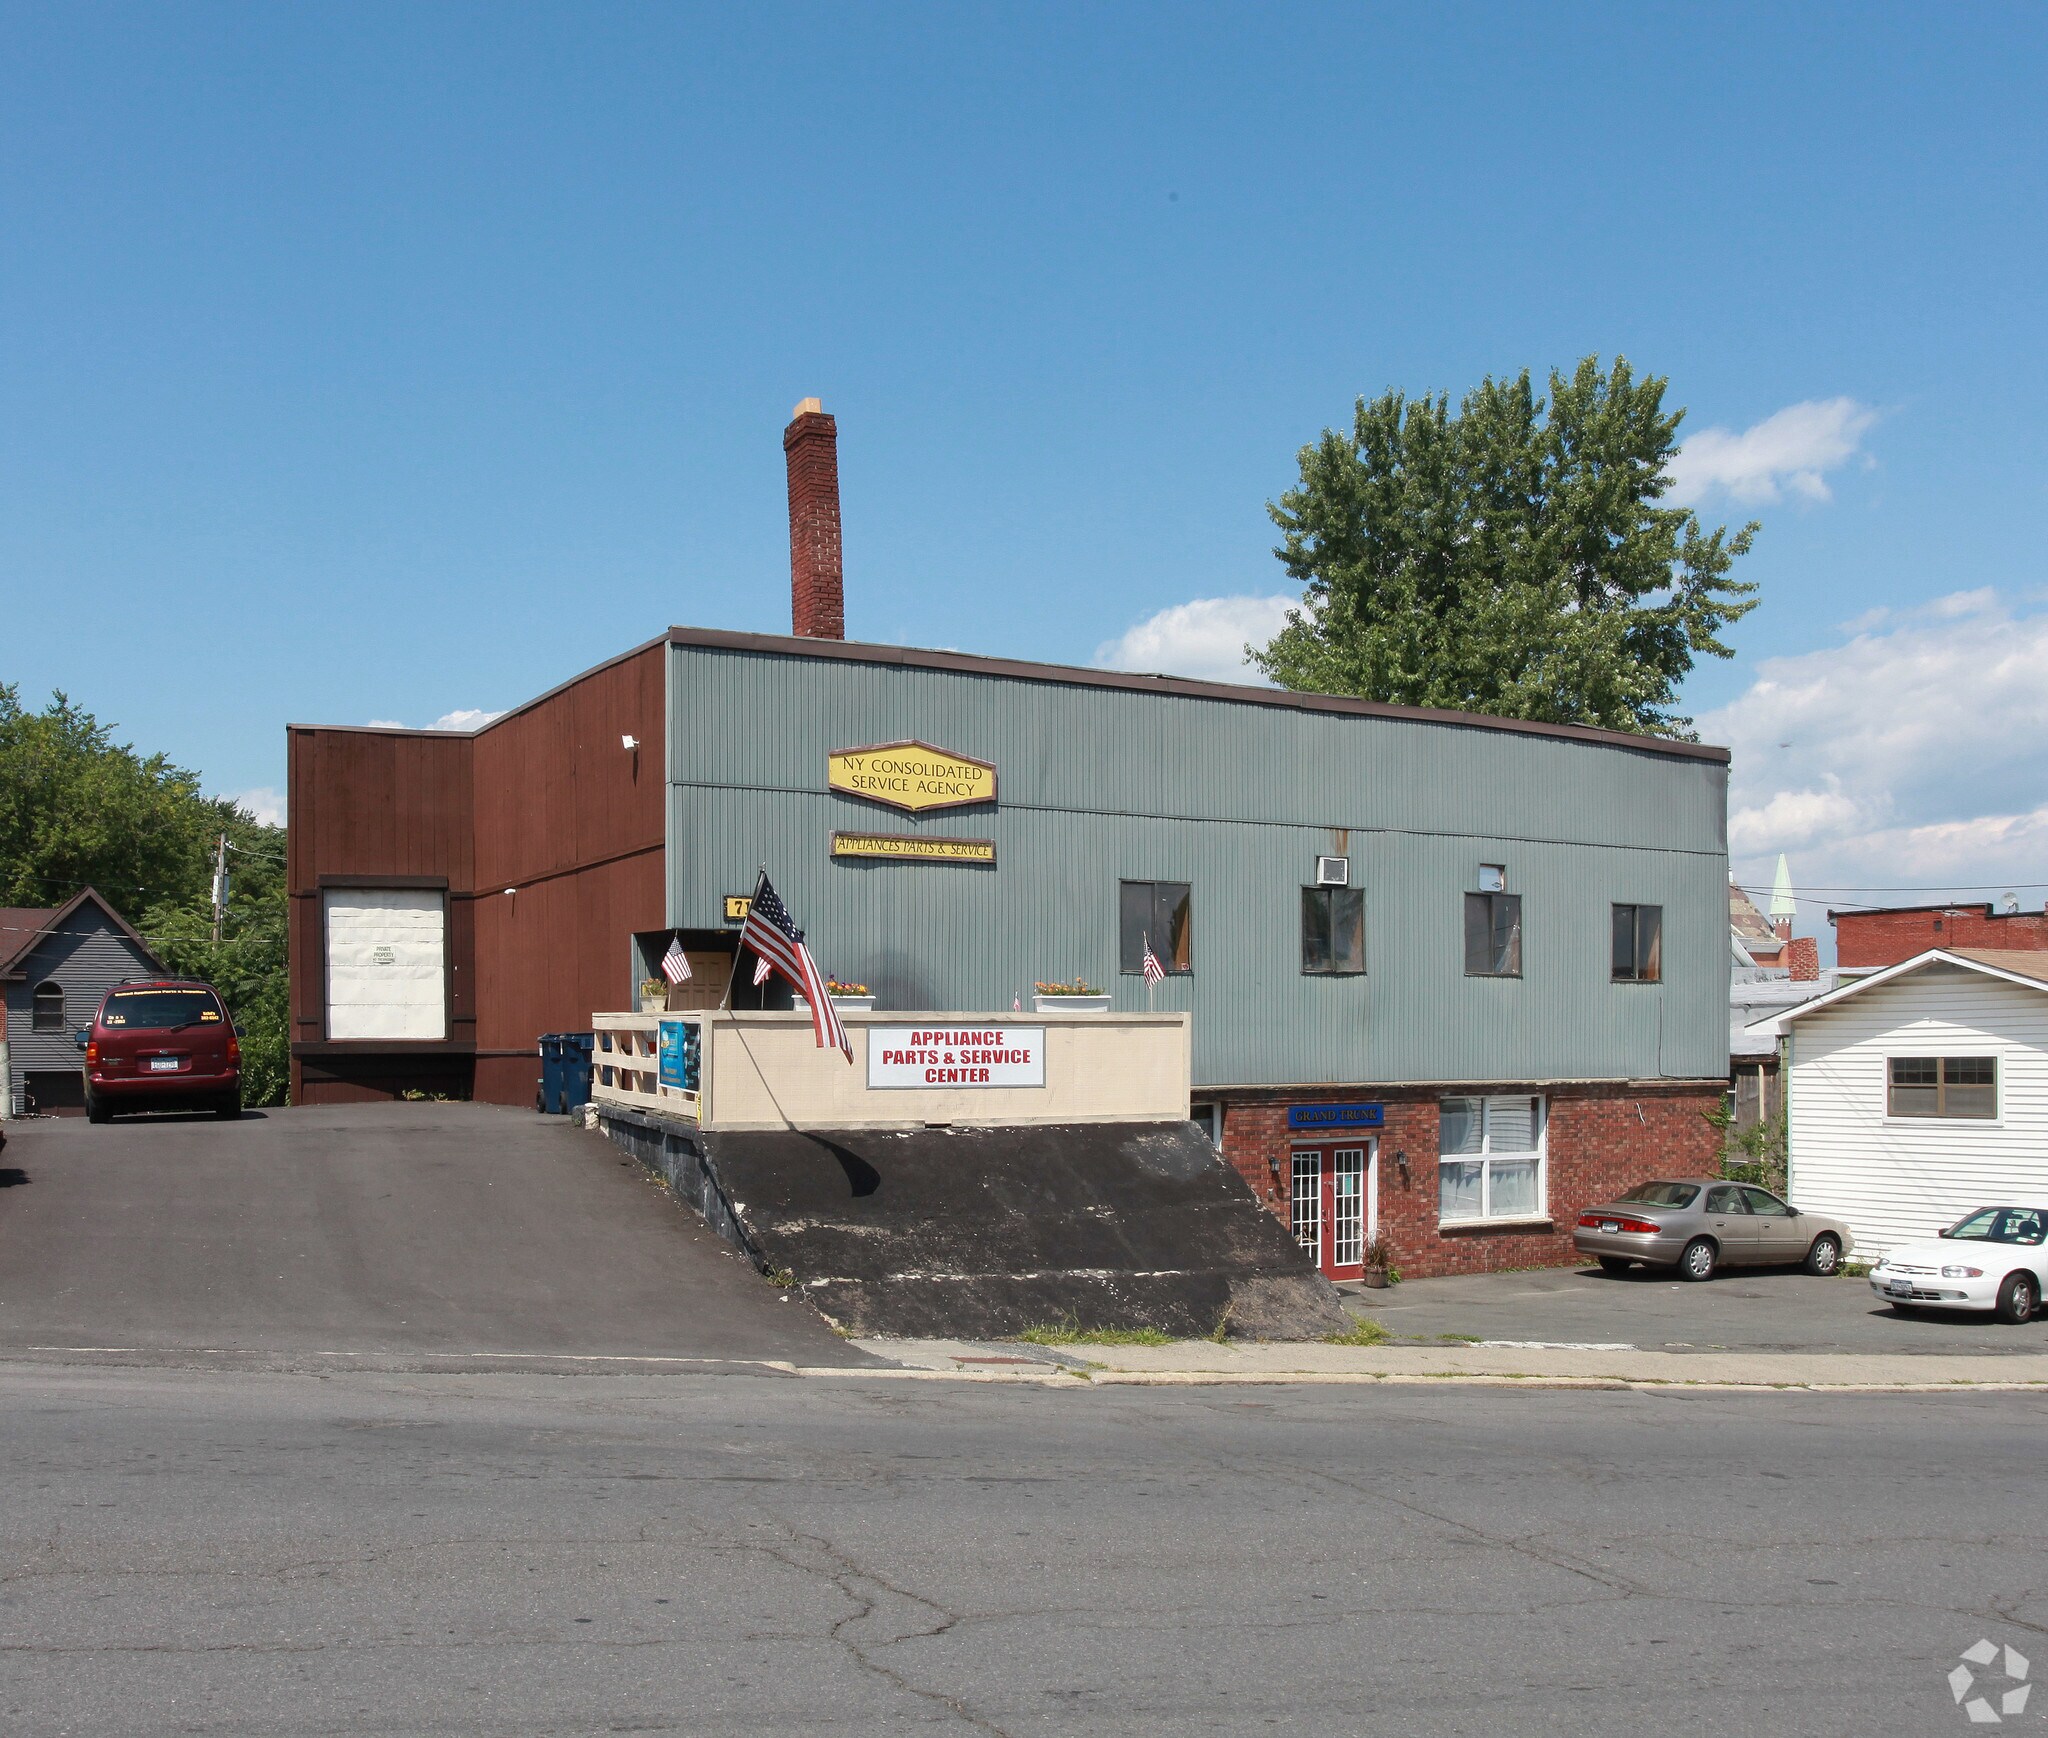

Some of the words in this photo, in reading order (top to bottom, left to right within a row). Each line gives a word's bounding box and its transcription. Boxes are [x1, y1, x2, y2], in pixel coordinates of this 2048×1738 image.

[843, 757, 865, 771] NY
[871, 759, 983, 780] CONSOLIDATED
[851, 775, 910, 792] SERVICE
[916, 780, 975, 796] AGENCY
[837, 838, 901, 852] APPLIANCES
[903, 841, 935, 854] PARTS
[937, 843, 946, 854] &
[950, 843, 989, 856] SERVICE
[910, 1031, 1004, 1046] APPLIANCE
[882, 1050, 939, 1065] PARTS
[943, 1052, 956, 1064] &
[960, 1049, 1031, 1064] SERVICE
[925, 1068, 990, 1083] CENTER
[1295, 1110, 1337, 1122] GRAND
[1340, 1109, 1377, 1121] TRUNK
